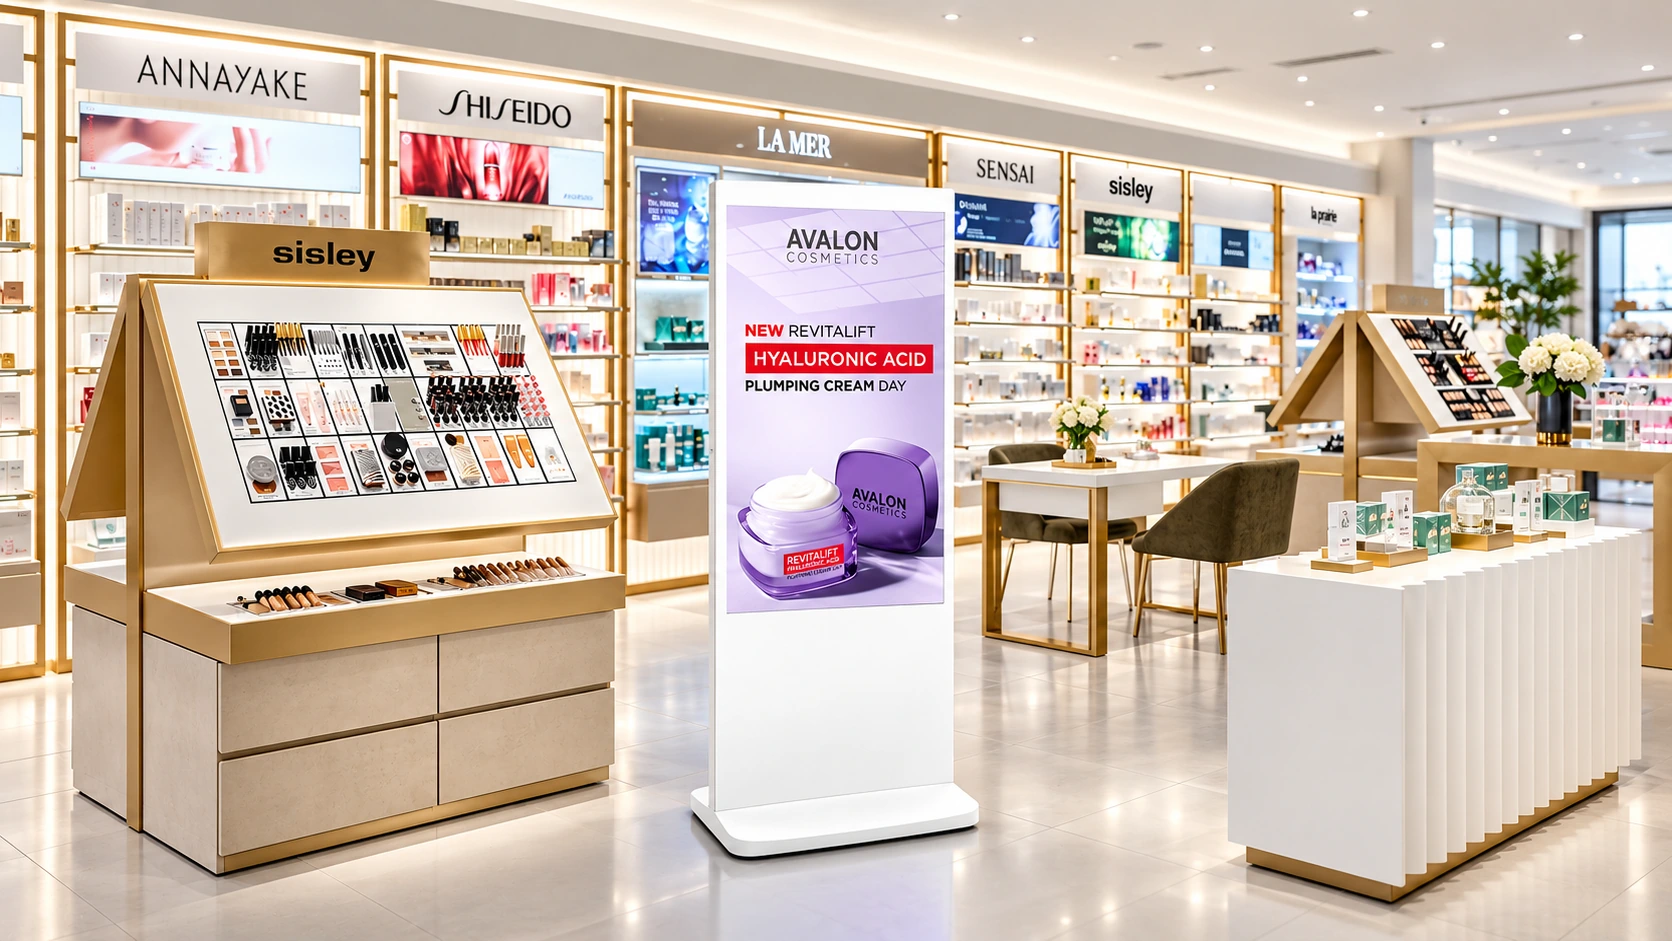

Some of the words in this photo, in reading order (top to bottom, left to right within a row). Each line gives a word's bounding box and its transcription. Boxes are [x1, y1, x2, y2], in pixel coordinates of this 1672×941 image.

[137, 55, 307, 101] ANNAYAKE
[439, 90, 571, 128] SHISEIDO
[757, 125, 786, 154] LA
[788, 130, 832, 159] MER
[976, 158, 1035, 185] SENSAI
[1109, 175, 1153, 203] sisley
[786, 228, 878, 251] AVALON
[273, 241, 376, 273] sisley
[786, 251, 879, 265] COSMETICS
[745, 324, 784, 337] NEW
[788, 324, 876, 338] REVITALIFT
[754, 351, 877, 367] HYALURONIC
[883, 351, 927, 367] ACID
[745, 380, 819, 392] PLUMPING
[823, 380, 874, 392] CREAM
[878, 380, 907, 392] DAY
[852, 487, 907, 511] AVALON
[852, 500, 907, 519] COSMETICS
[787, 547, 838, 566] REVITALIFT
